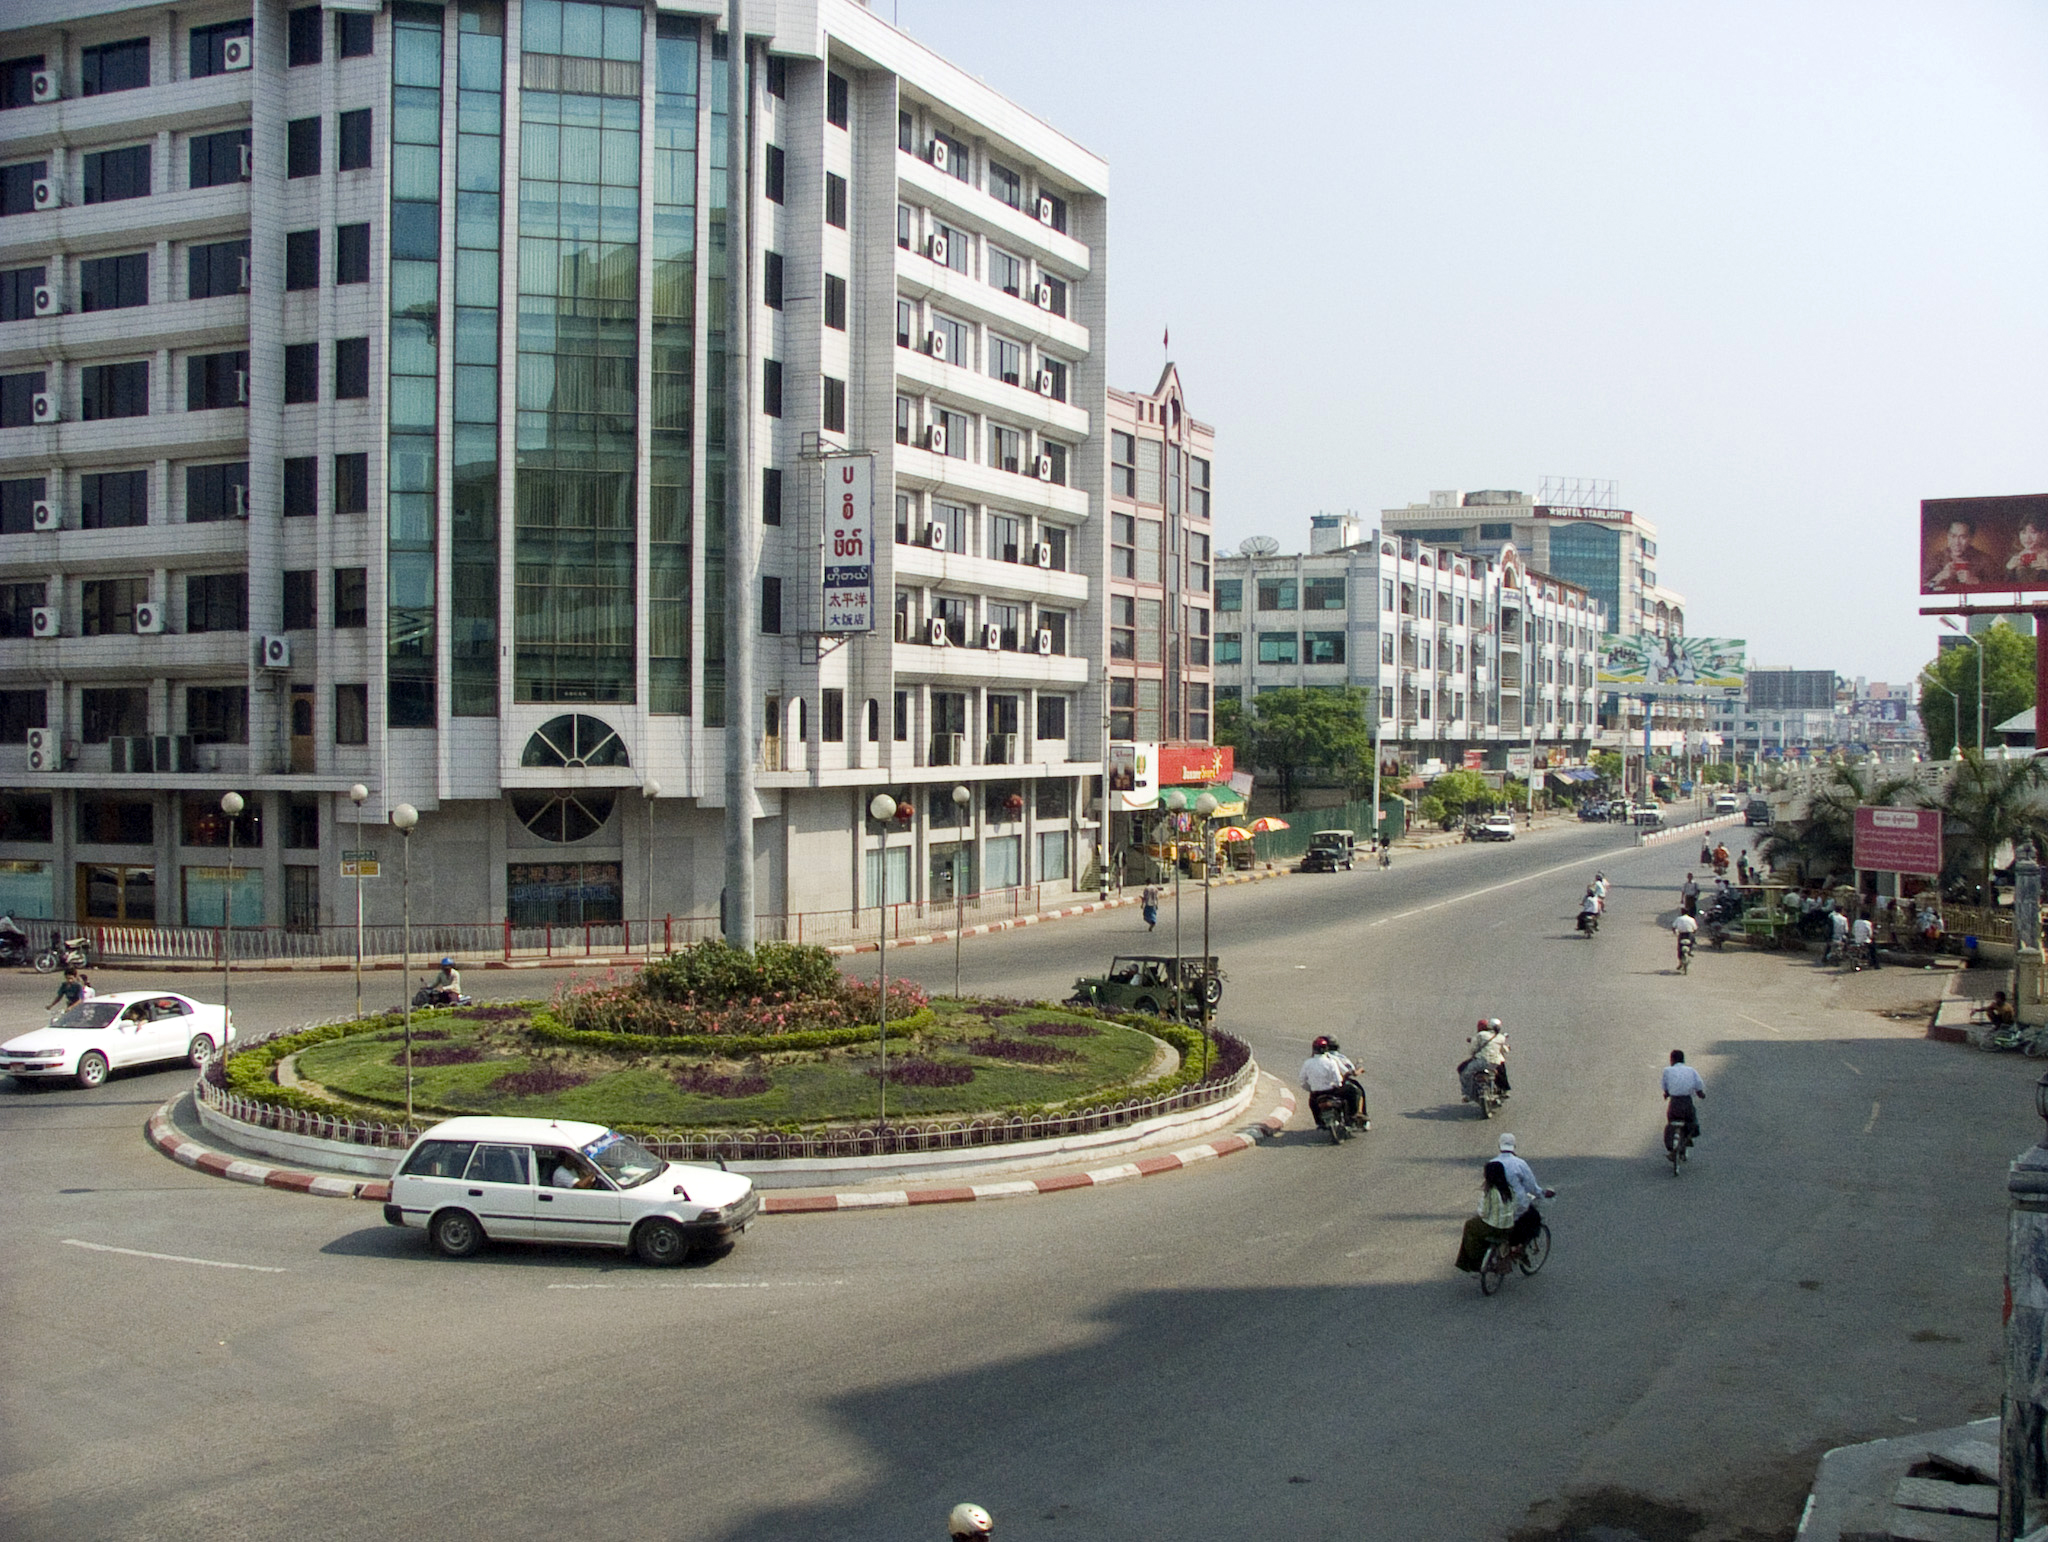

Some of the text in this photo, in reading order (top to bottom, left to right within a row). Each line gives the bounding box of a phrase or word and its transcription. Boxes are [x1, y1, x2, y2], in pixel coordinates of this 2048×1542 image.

[1556, 507, 1625, 520] HOTEL STARLIGHT
[826, 566, 868, 586] ဟိုတယ်
[828, 591, 868, 608] 太平洋
[829, 613, 865, 626] 大饭店
[514, 884, 615, 902] PACIFIC HOTEL
